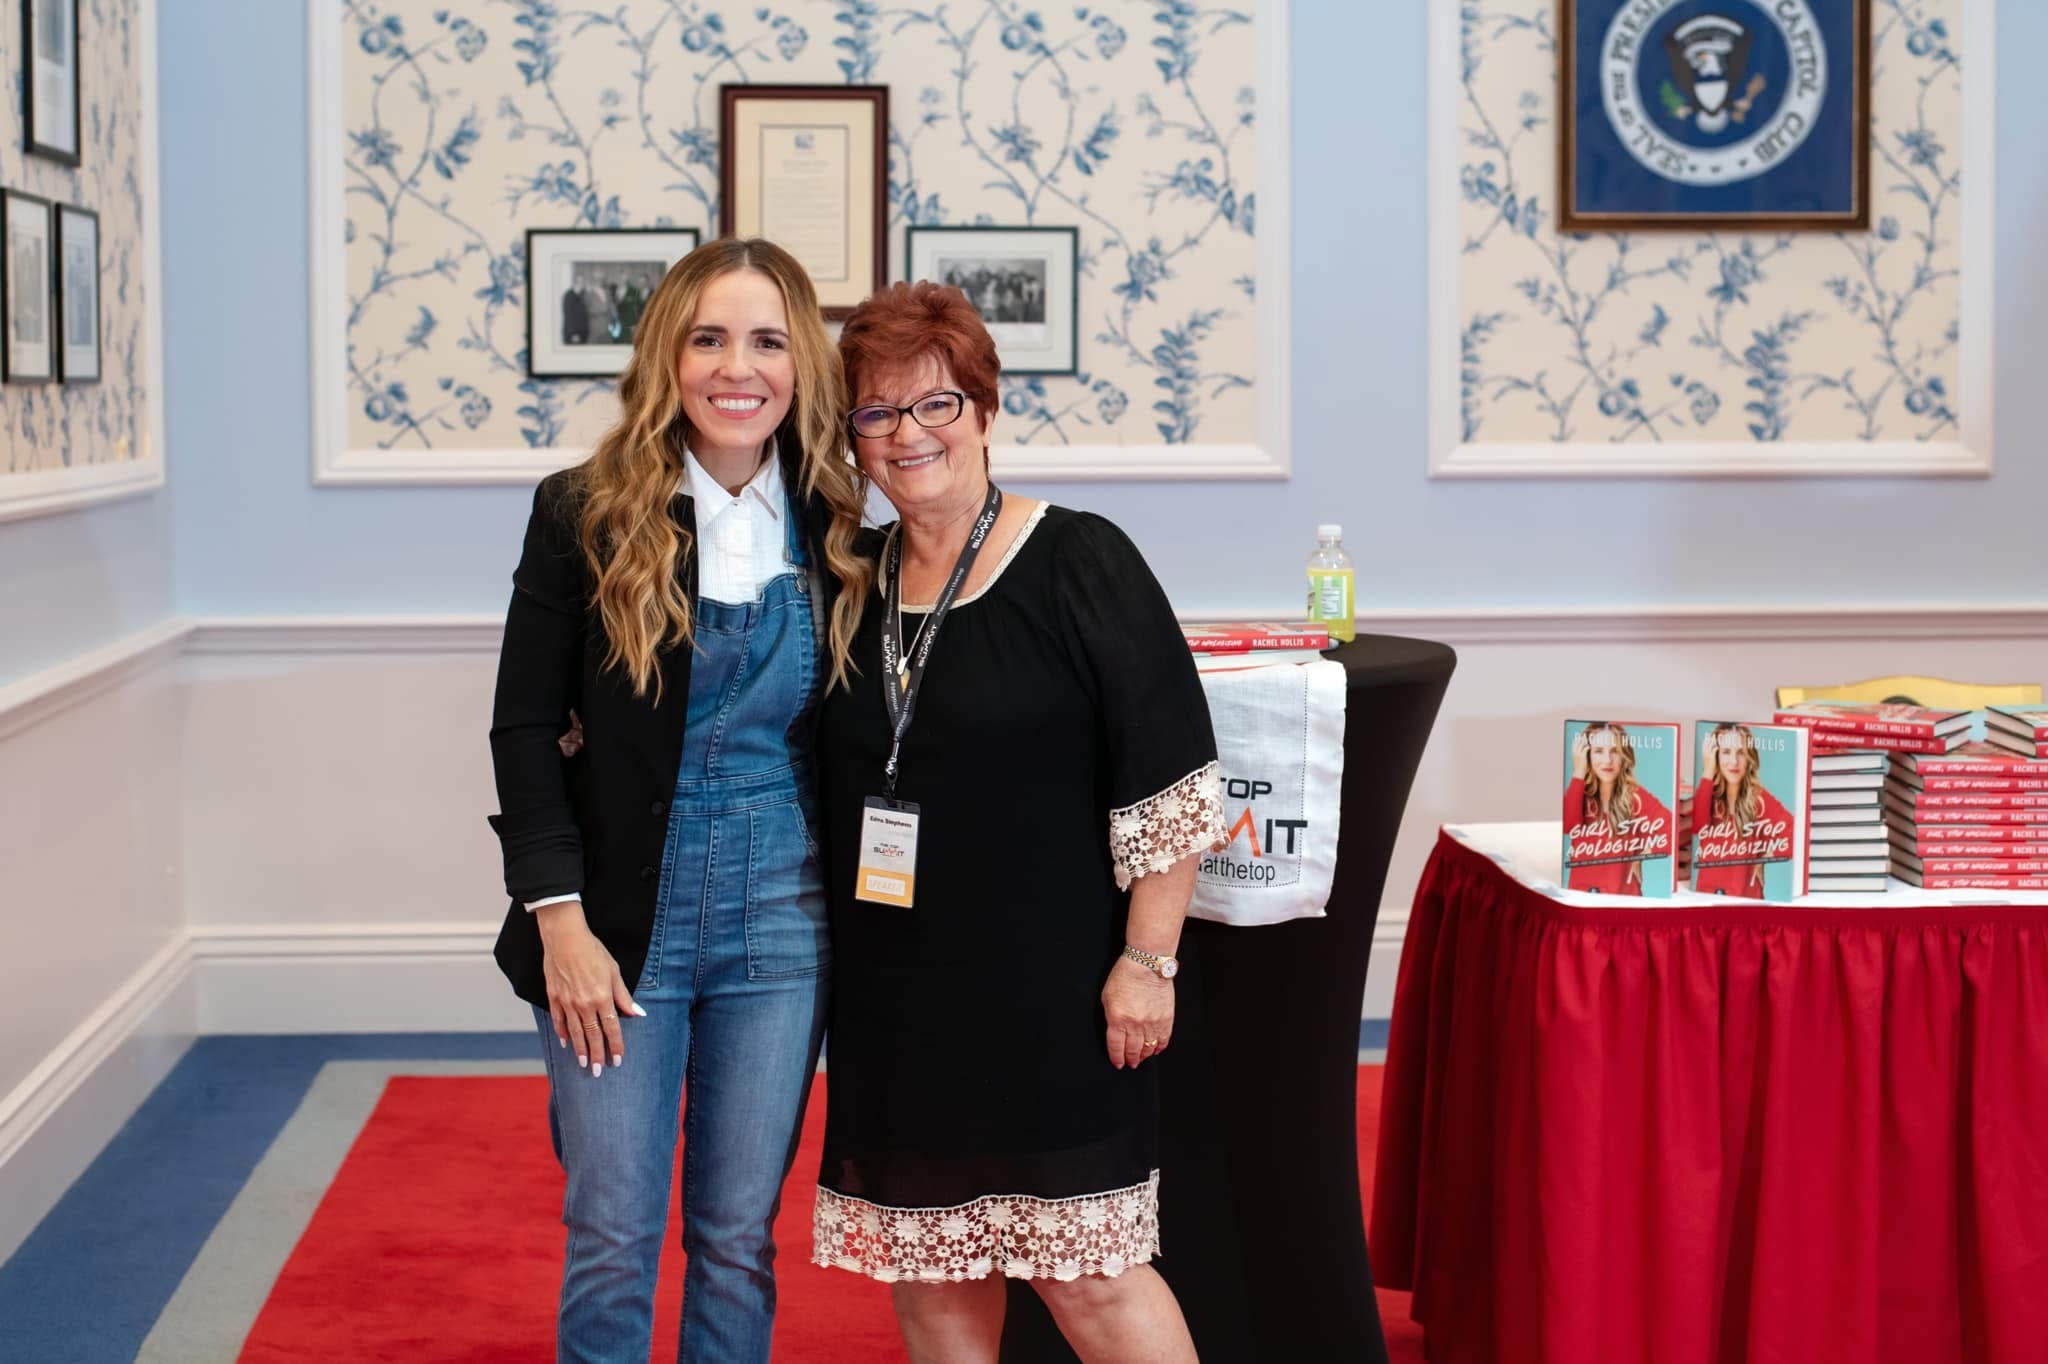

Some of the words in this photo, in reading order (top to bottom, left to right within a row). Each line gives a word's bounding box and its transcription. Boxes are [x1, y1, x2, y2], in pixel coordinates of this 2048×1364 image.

[1754, 111, 1804, 163] CLUB
[1632, 125, 1687, 174] SEAL
[972, 510, 996, 549] SUMMIT
[1253, 639, 1279, 647] RACHEL
[1280, 638, 1304, 646] HOLLIS
[1622, 735, 1663, 749] HOLLIS
[1747, 736, 1785, 751] HOLLIS
[1220, 777, 1272, 800] OP
[1569, 820, 1612, 839] GIRL,
[1617, 816, 1664, 835] STOP
[1698, 821, 1738, 840] GIRL,
[1742, 819, 1786, 837] STOP
[1567, 834, 1668, 858] APOLOGIZING
[1695, 837, 1790, 859] APOLOGIZING
